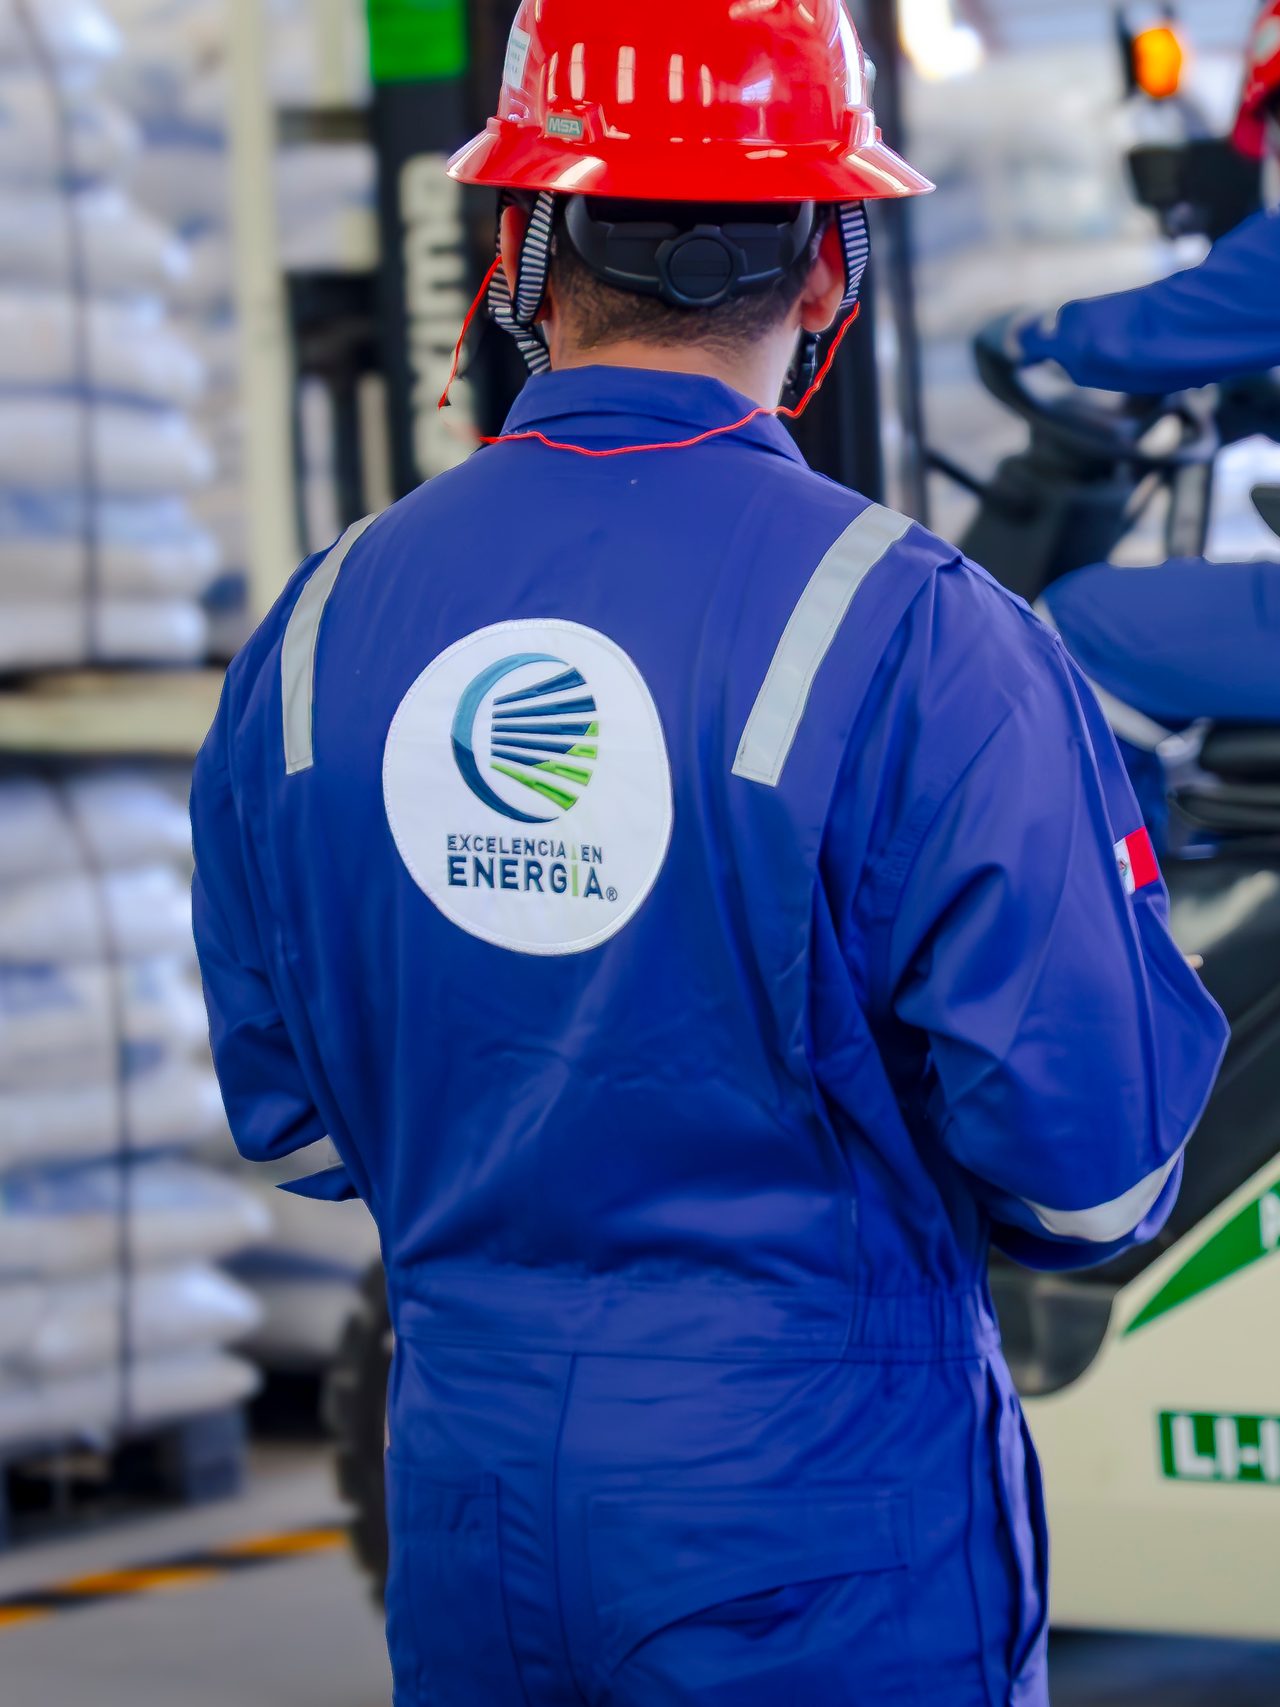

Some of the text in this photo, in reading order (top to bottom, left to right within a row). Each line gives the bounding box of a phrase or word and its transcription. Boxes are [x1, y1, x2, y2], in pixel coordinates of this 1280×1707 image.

[549, 117, 581, 135] MSA
[447, 834, 602, 864] EXCELENCIA EN
